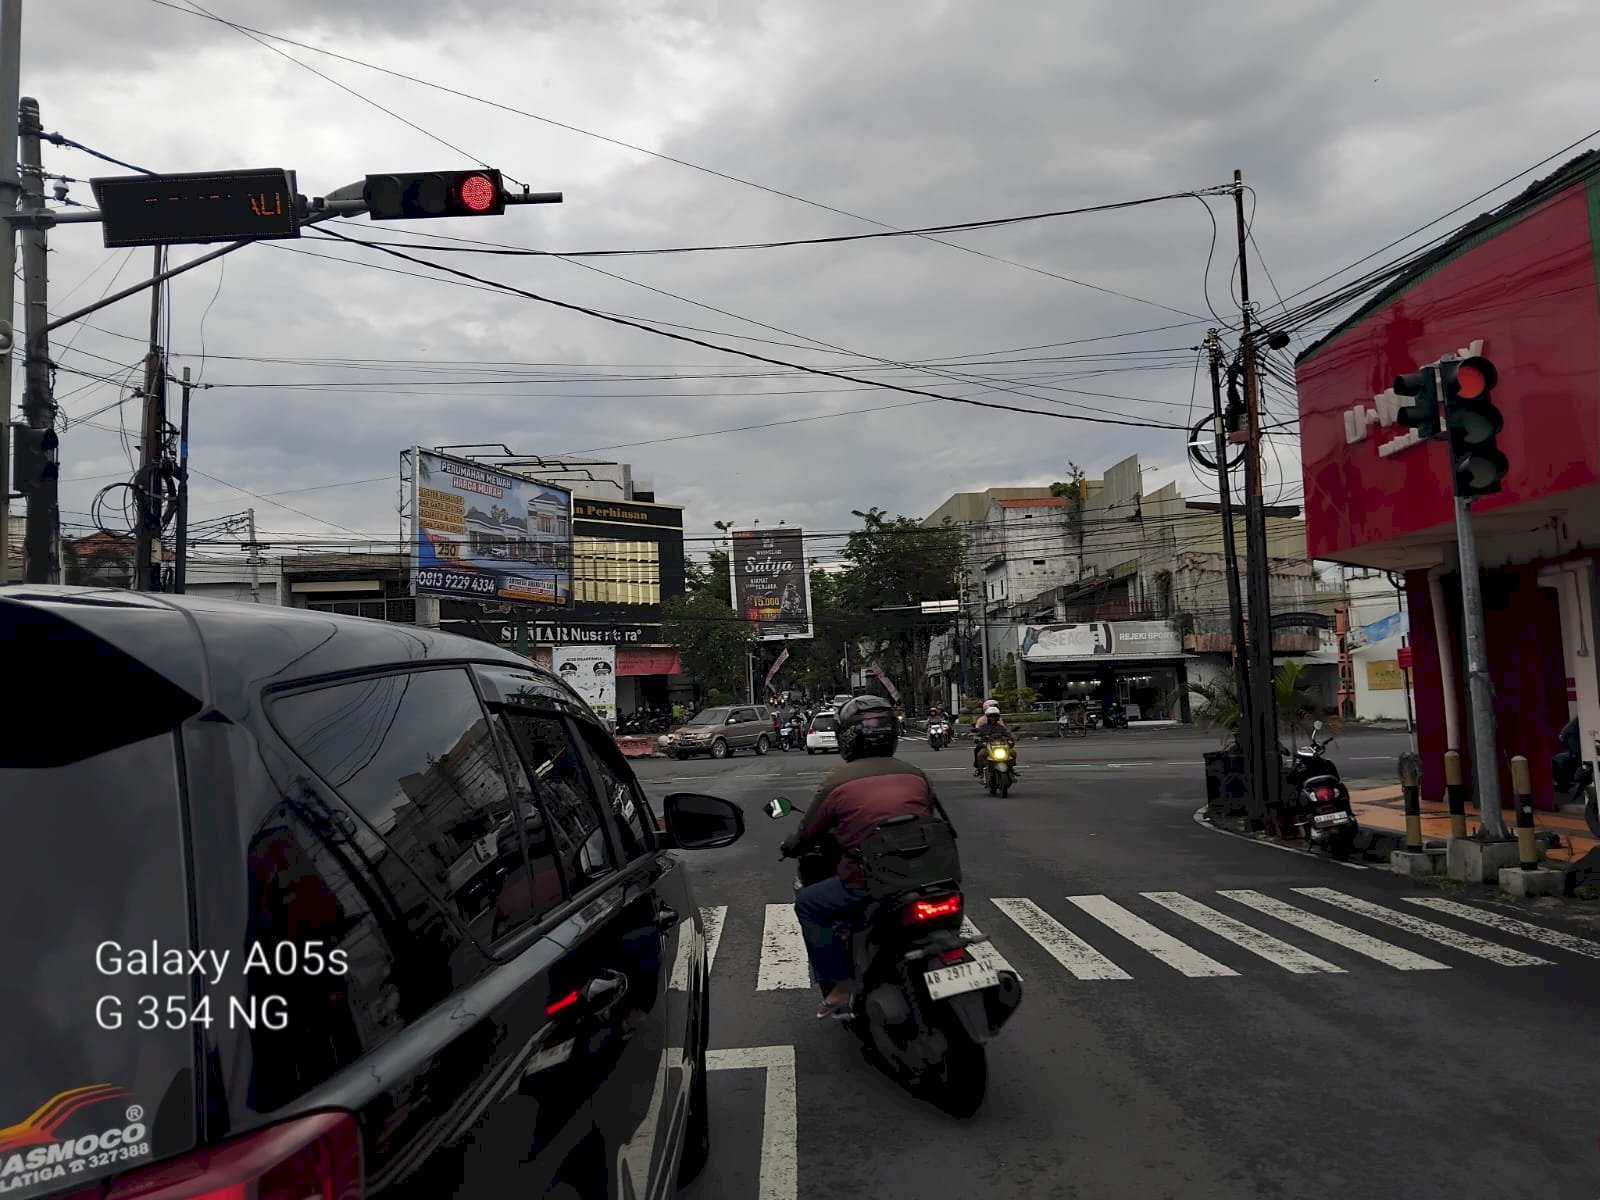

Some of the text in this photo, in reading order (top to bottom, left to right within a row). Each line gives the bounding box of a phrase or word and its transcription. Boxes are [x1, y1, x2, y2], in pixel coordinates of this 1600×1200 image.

[441, 461, 512, 489] PERUMAHAN MEWAH
[453, 477, 503, 499] HARGA MURAH
[586, 504, 649, 521] Perhiasan
[437, 543, 457, 557] 250
[745, 556, 794, 577] Satya
[418, 571, 443, 587] 0813
[445, 575, 472, 590] 9229
[471, 578, 495, 593] 4334
[1119, 632, 1147, 641] REJEKI
[1148, 631, 1174, 640] SPORT
[926, 972, 941, 986] AB
[0, 1123, 146, 1178] ASMOCO
[88, 1143, 149, 1169] 327388
